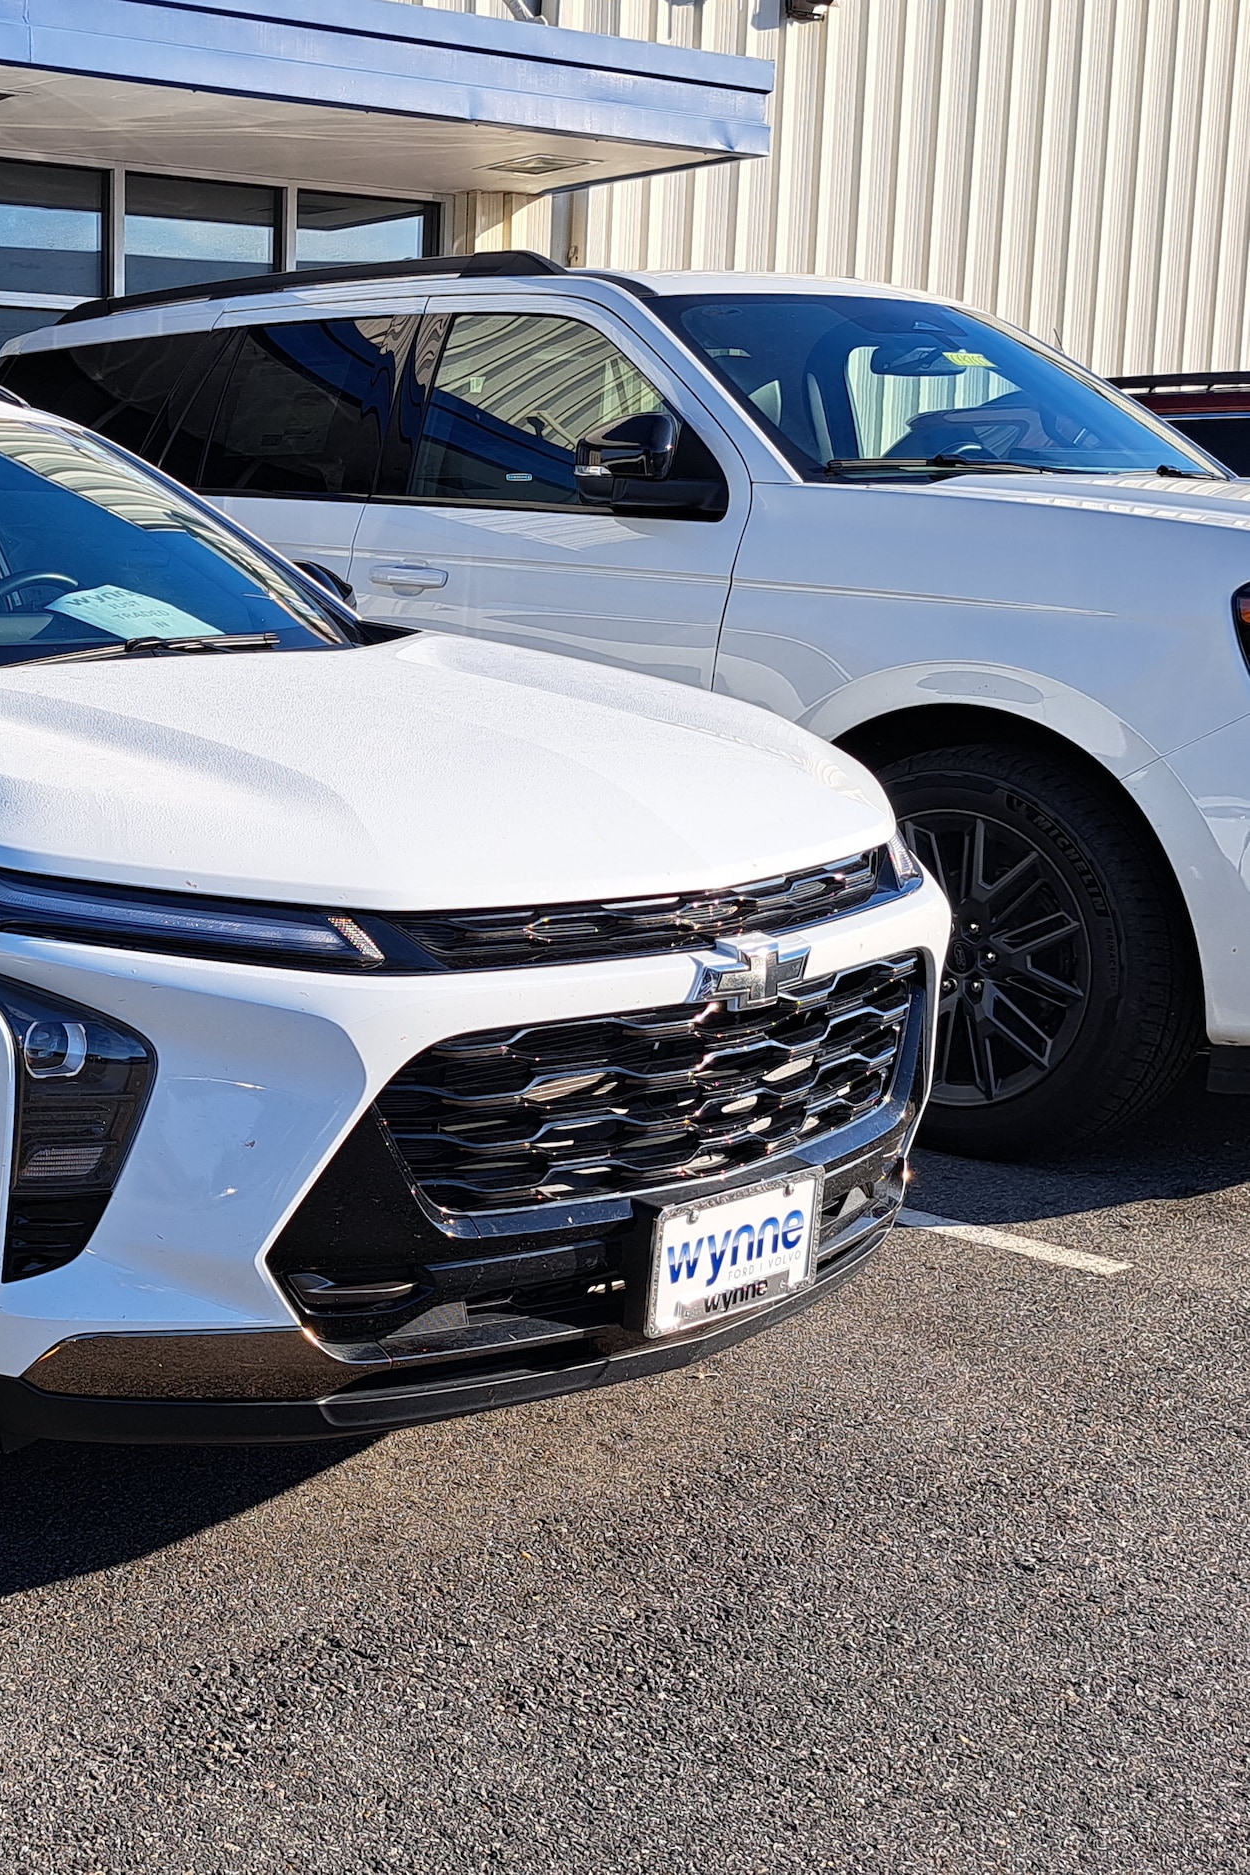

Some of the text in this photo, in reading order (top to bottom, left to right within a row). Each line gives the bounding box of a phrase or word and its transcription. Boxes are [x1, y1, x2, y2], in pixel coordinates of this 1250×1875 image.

[109, 600, 142, 610] JUST
[112, 610, 170, 620] TRADED
[151, 620, 171, 629] IN
[1032, 815, 1107, 913] MICHELIN
[666, 1209, 805, 1288] wynne
[727, 1264, 755, 1281] FORD
[768, 1250, 802, 1268] VOLVO
[704, 1279, 768, 1314] wynne
